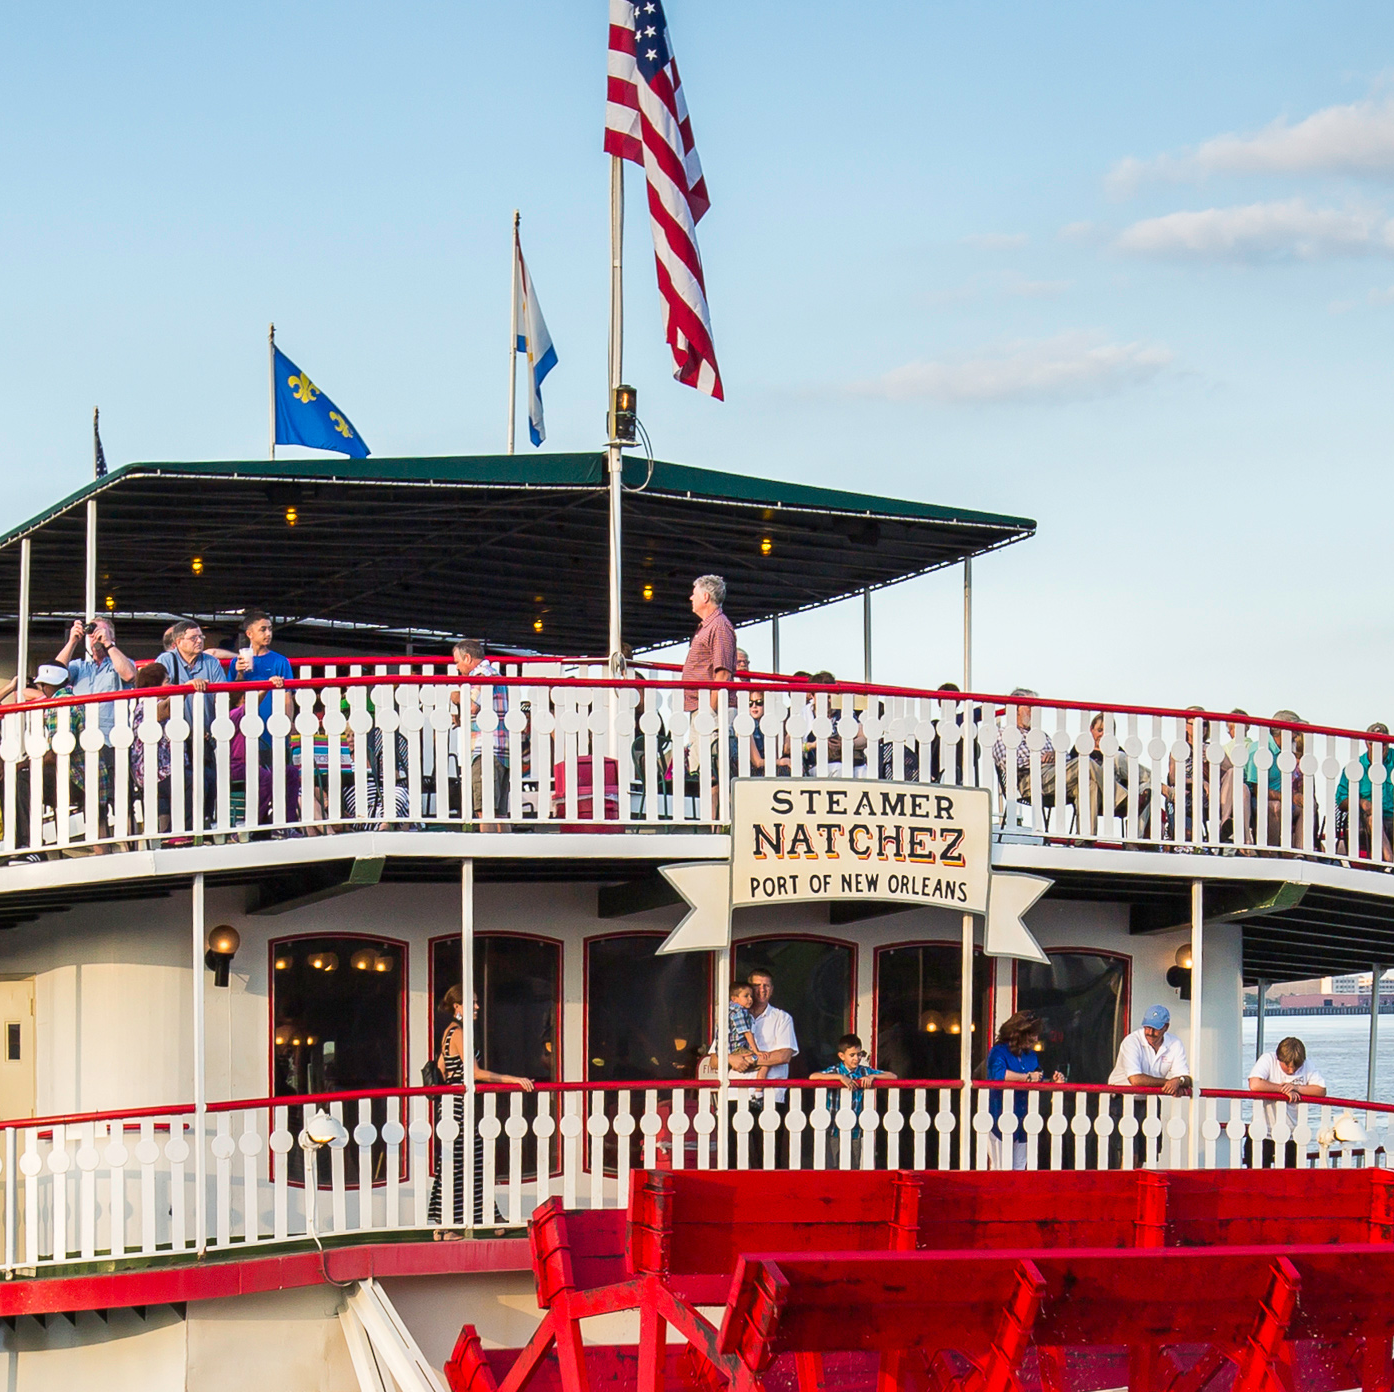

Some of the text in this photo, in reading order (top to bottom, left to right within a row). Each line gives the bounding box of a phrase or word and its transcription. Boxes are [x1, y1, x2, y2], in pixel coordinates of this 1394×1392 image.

[771, 789, 954, 820] STEAMER
[752, 823, 966, 867] NATCHEZ
[750, 872, 968, 903] PORT OF NEW ORLEANS
